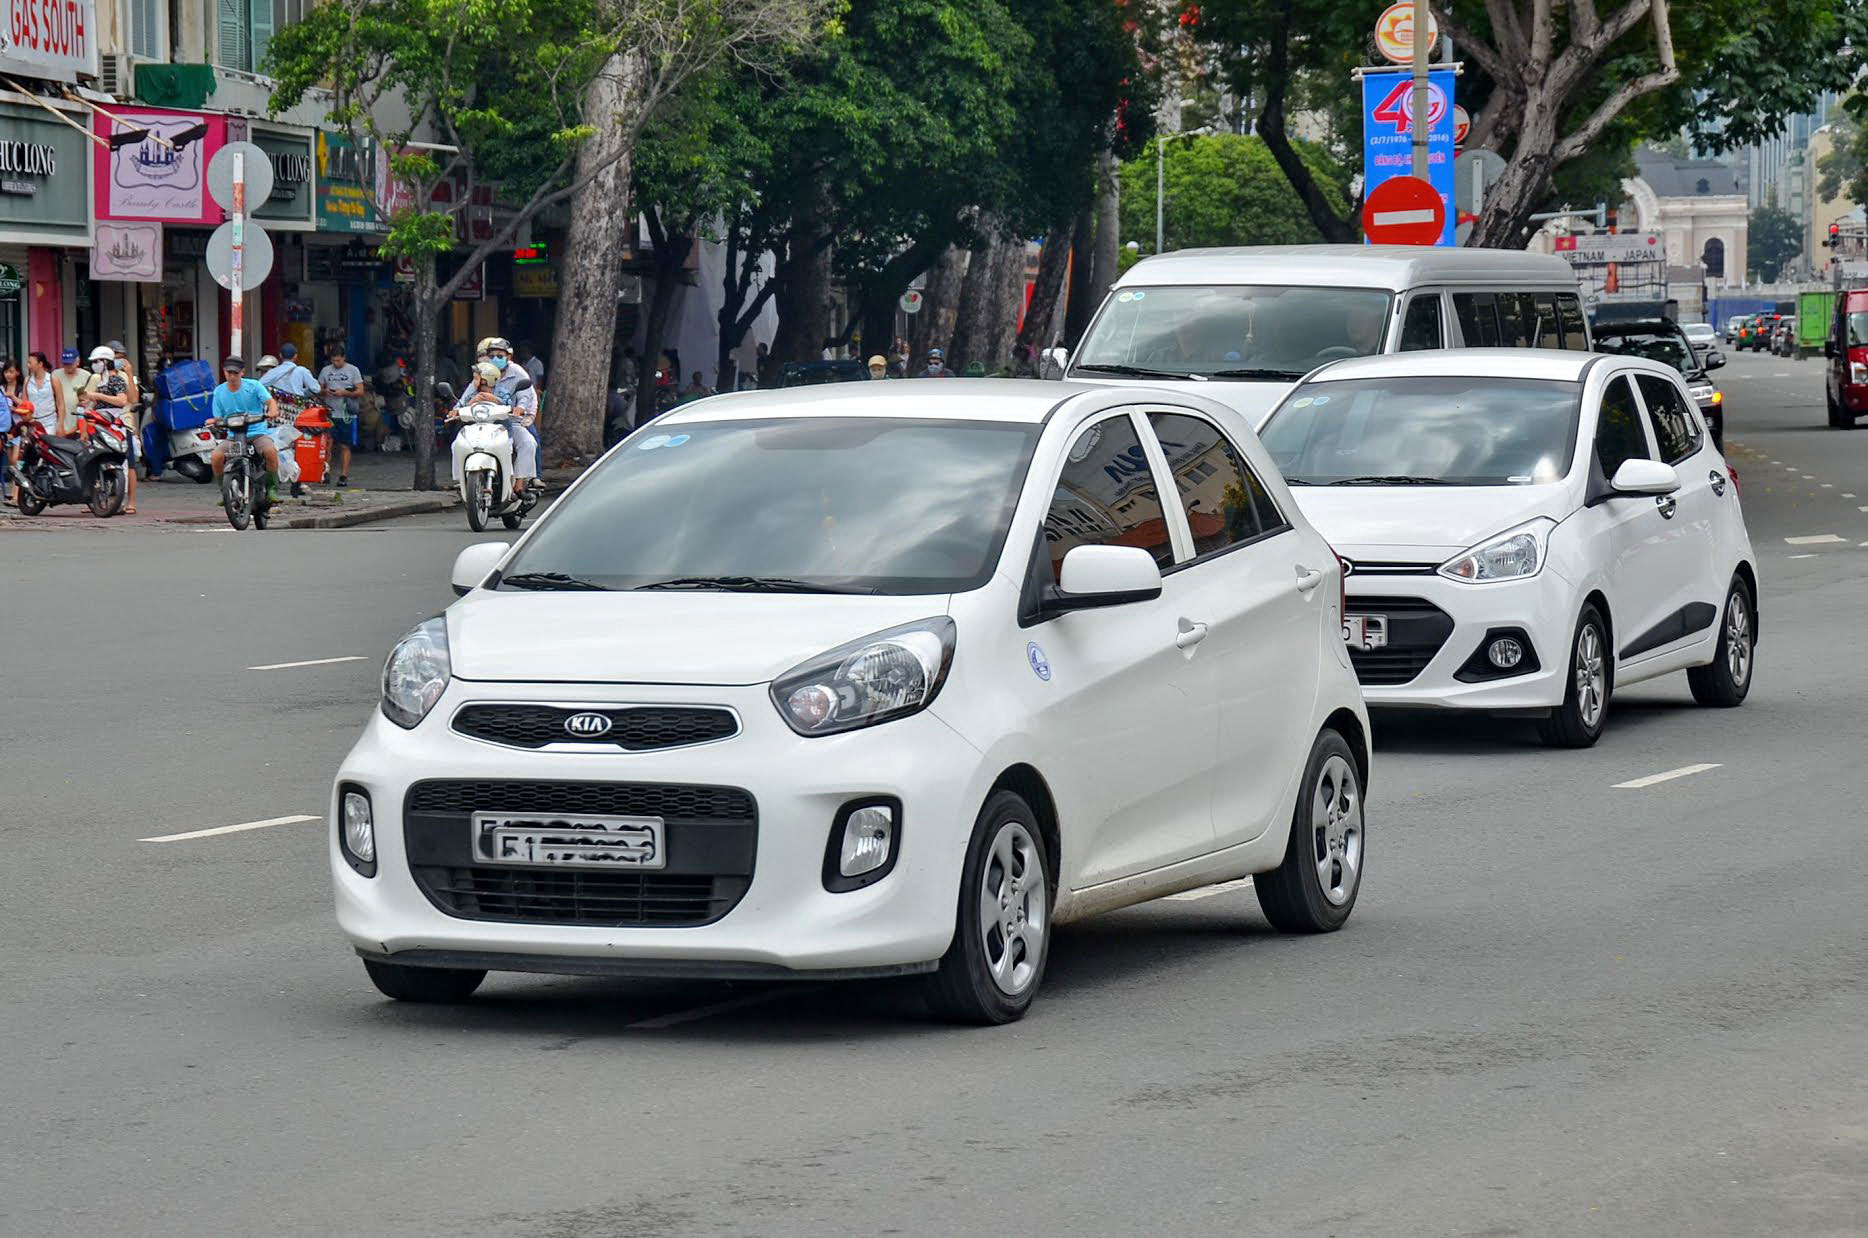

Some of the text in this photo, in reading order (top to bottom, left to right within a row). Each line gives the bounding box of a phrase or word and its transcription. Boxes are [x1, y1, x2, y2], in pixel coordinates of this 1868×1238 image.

[10, 0, 85, 59] GAS SOUTH
[24, 142, 56, 176] LONG
[286, 153, 310, 183] LONG
[1562, 251, 1605, 262] VIETNAM
[1623, 249, 1656, 261] JAPAN
[571, 716, 603, 732] KIA
